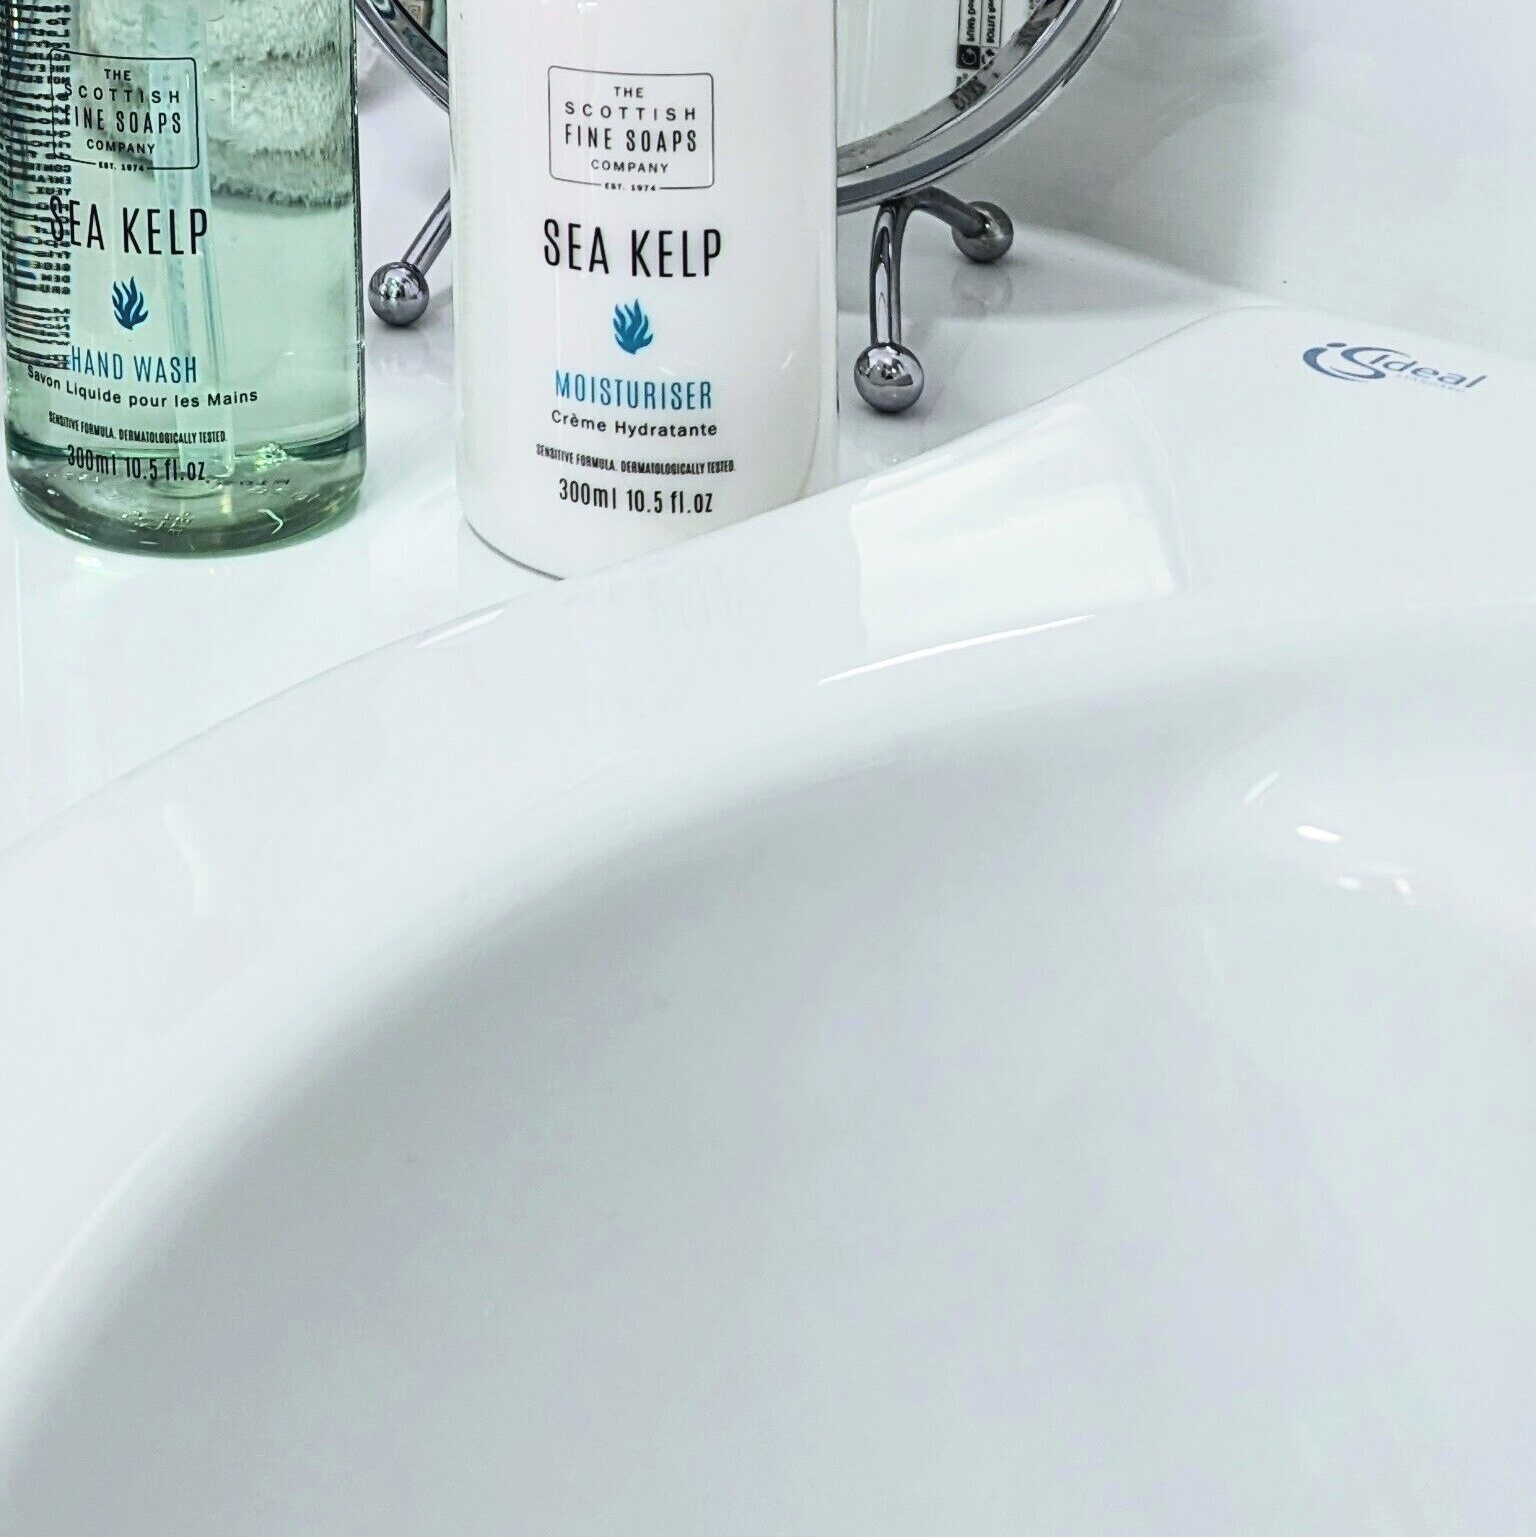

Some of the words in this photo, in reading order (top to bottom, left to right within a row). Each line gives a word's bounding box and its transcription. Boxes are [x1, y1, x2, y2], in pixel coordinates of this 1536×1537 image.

[104, 68, 132, 81] THE
[64, 82, 180, 104] SCOTTISH
[613, 85, 645, 99] THE
[115, 110, 182, 134] SOAPS
[565, 100, 697, 122] SCOTTISH
[86, 139, 156, 154] COMPANY
[565, 123, 614, 150] FINE
[625, 129, 698, 153] SOAPS
[590, 158, 670, 174] COMPANY
[604, 181, 626, 190] EST.
[630, 183, 657, 192] 1974
[49, 195, 105, 251] SEA
[123, 207, 208, 255] KELP
[543, 217, 610, 275] SEA
[630, 228, 723, 278] KELP
[70, 345, 124, 381] HAND
[134, 355, 198, 384] WASH
[1369, 354, 1488, 388] Ideal
[27, 364, 61, 391] Savon
[65, 383, 122, 404] Liquide
[129, 395, 167, 408] pour
[174, 394, 200, 408] les
[208, 389, 259, 407] Mains
[554, 369, 713, 411] MOISTURISER
[48, 410, 80, 433] SENSITIVE
[118, 428, 198, 445] DERMATOLOGICALLY
[551, 409, 607, 433] Crème
[614, 419, 718, 438] Hydratante
[67, 444, 117, 477] 300ml
[125, 456, 158, 480] 10.5
[536, 443, 575, 464] SENSITIVE
[620, 459, 706, 476] DERMATOLOGICALLY
[559, 477, 618, 511] 300ml
[626, 489, 664, 514] 10.5
[670, 490, 714, 515] fl.oz
